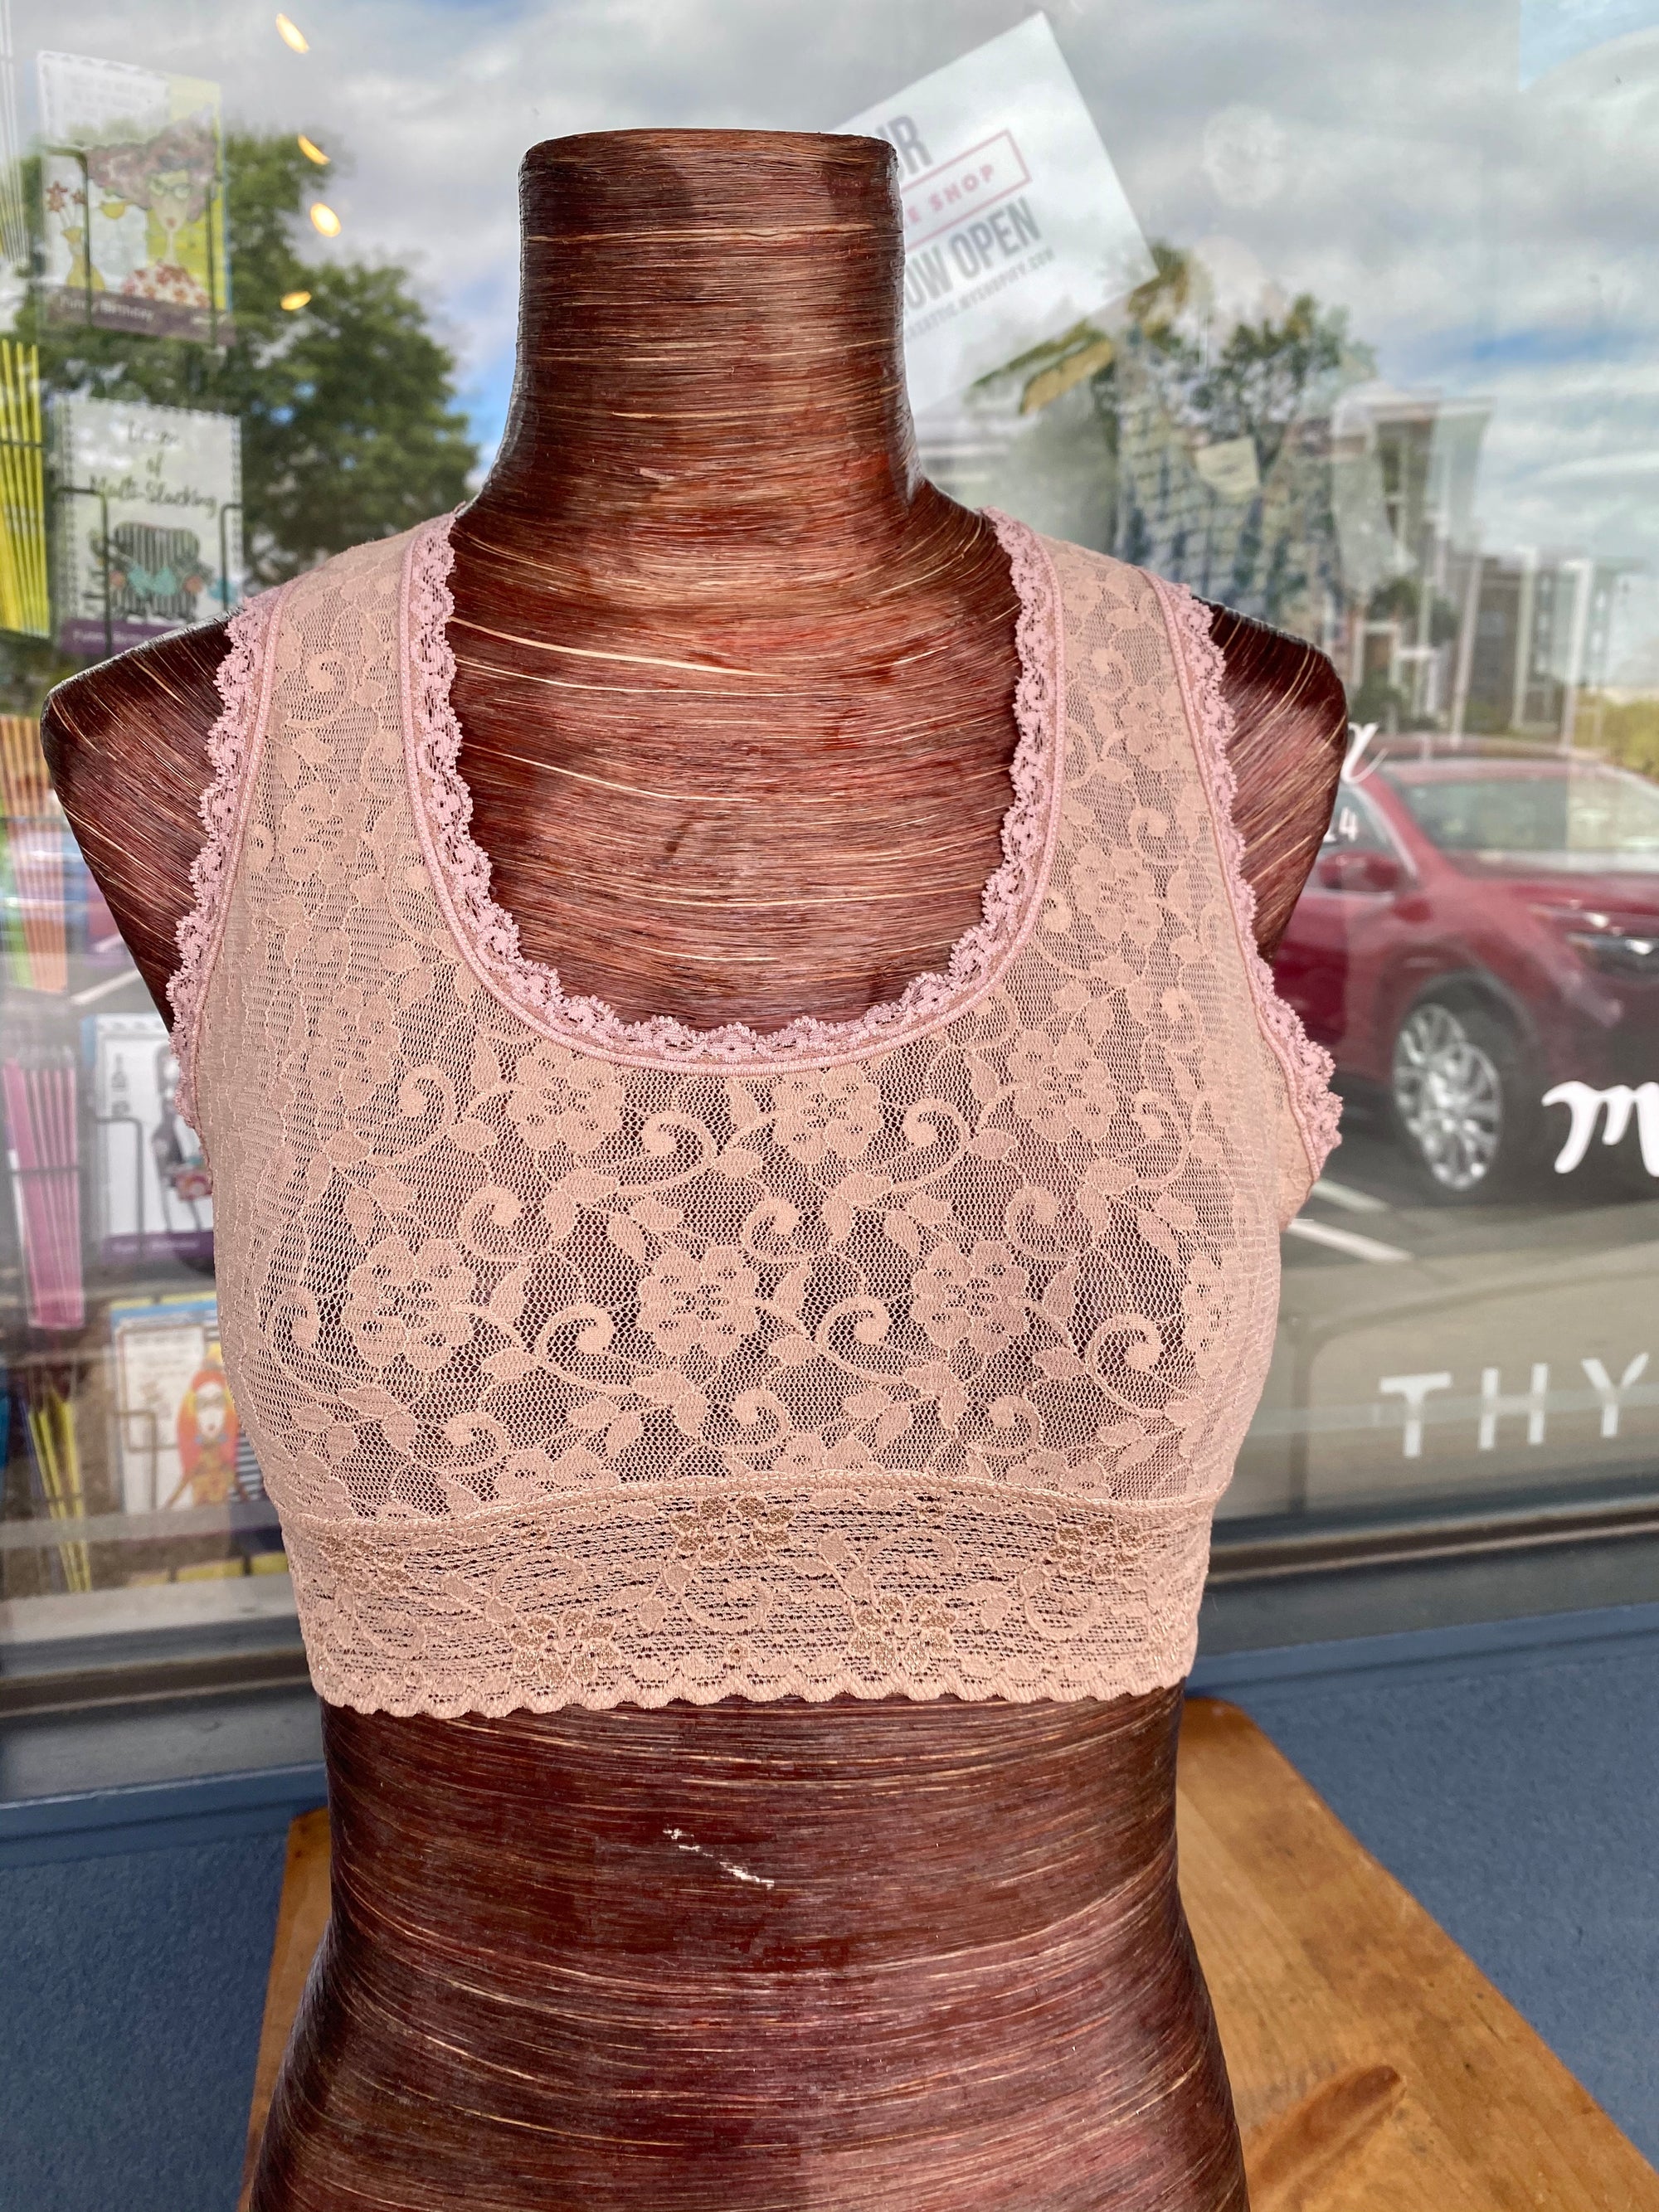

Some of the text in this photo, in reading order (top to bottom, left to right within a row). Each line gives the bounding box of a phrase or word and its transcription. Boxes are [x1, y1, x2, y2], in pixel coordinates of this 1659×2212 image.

[928, 163, 995, 211] SHOP
[902, 195, 1041, 315] OW OPEN
